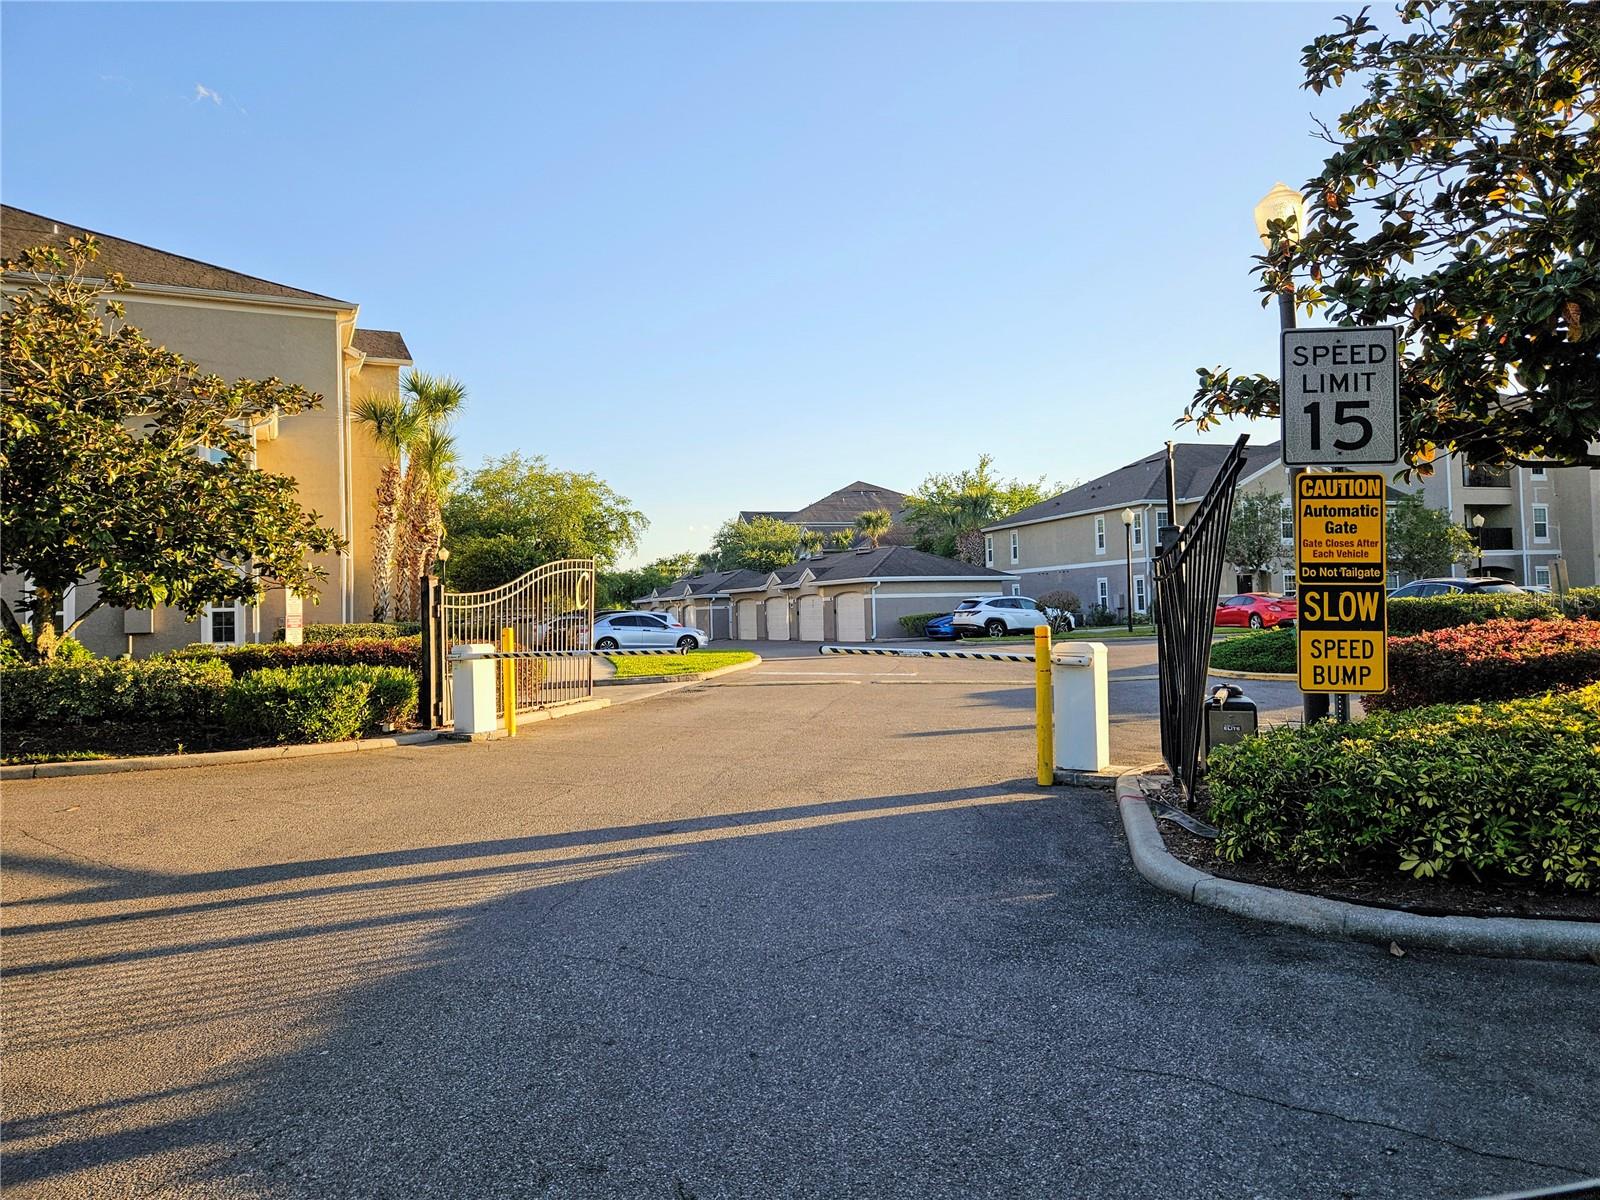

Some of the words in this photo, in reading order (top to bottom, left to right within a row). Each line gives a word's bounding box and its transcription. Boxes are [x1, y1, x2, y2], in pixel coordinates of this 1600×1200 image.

[1292, 344, 1387, 366] SPEED
[1302, 372, 1377, 393] LIMIT
[1304, 400, 1373, 450] 15
[1301, 479, 1380, 497] CAUTION
[1303, 504, 1379, 517] Automatic
[1325, 521, 1358, 534] Gate
[1302, 539, 1323, 548] Gate
[1325, 539, 1355, 548] Closes
[1356, 539, 1379, 548] After
[1312, 549, 1334, 558] Each
[1336, 549, 1369, 558] Vehicle
[1302, 567, 1317, 577] Do
[1319, 567, 1338, 577] Not
[1340, 567, 1380, 579] Tailgate
[1303, 591, 1380, 622] SLOW
[1310, 639, 1374, 659] SPEED
[1313, 665, 1372, 685] BUMP
